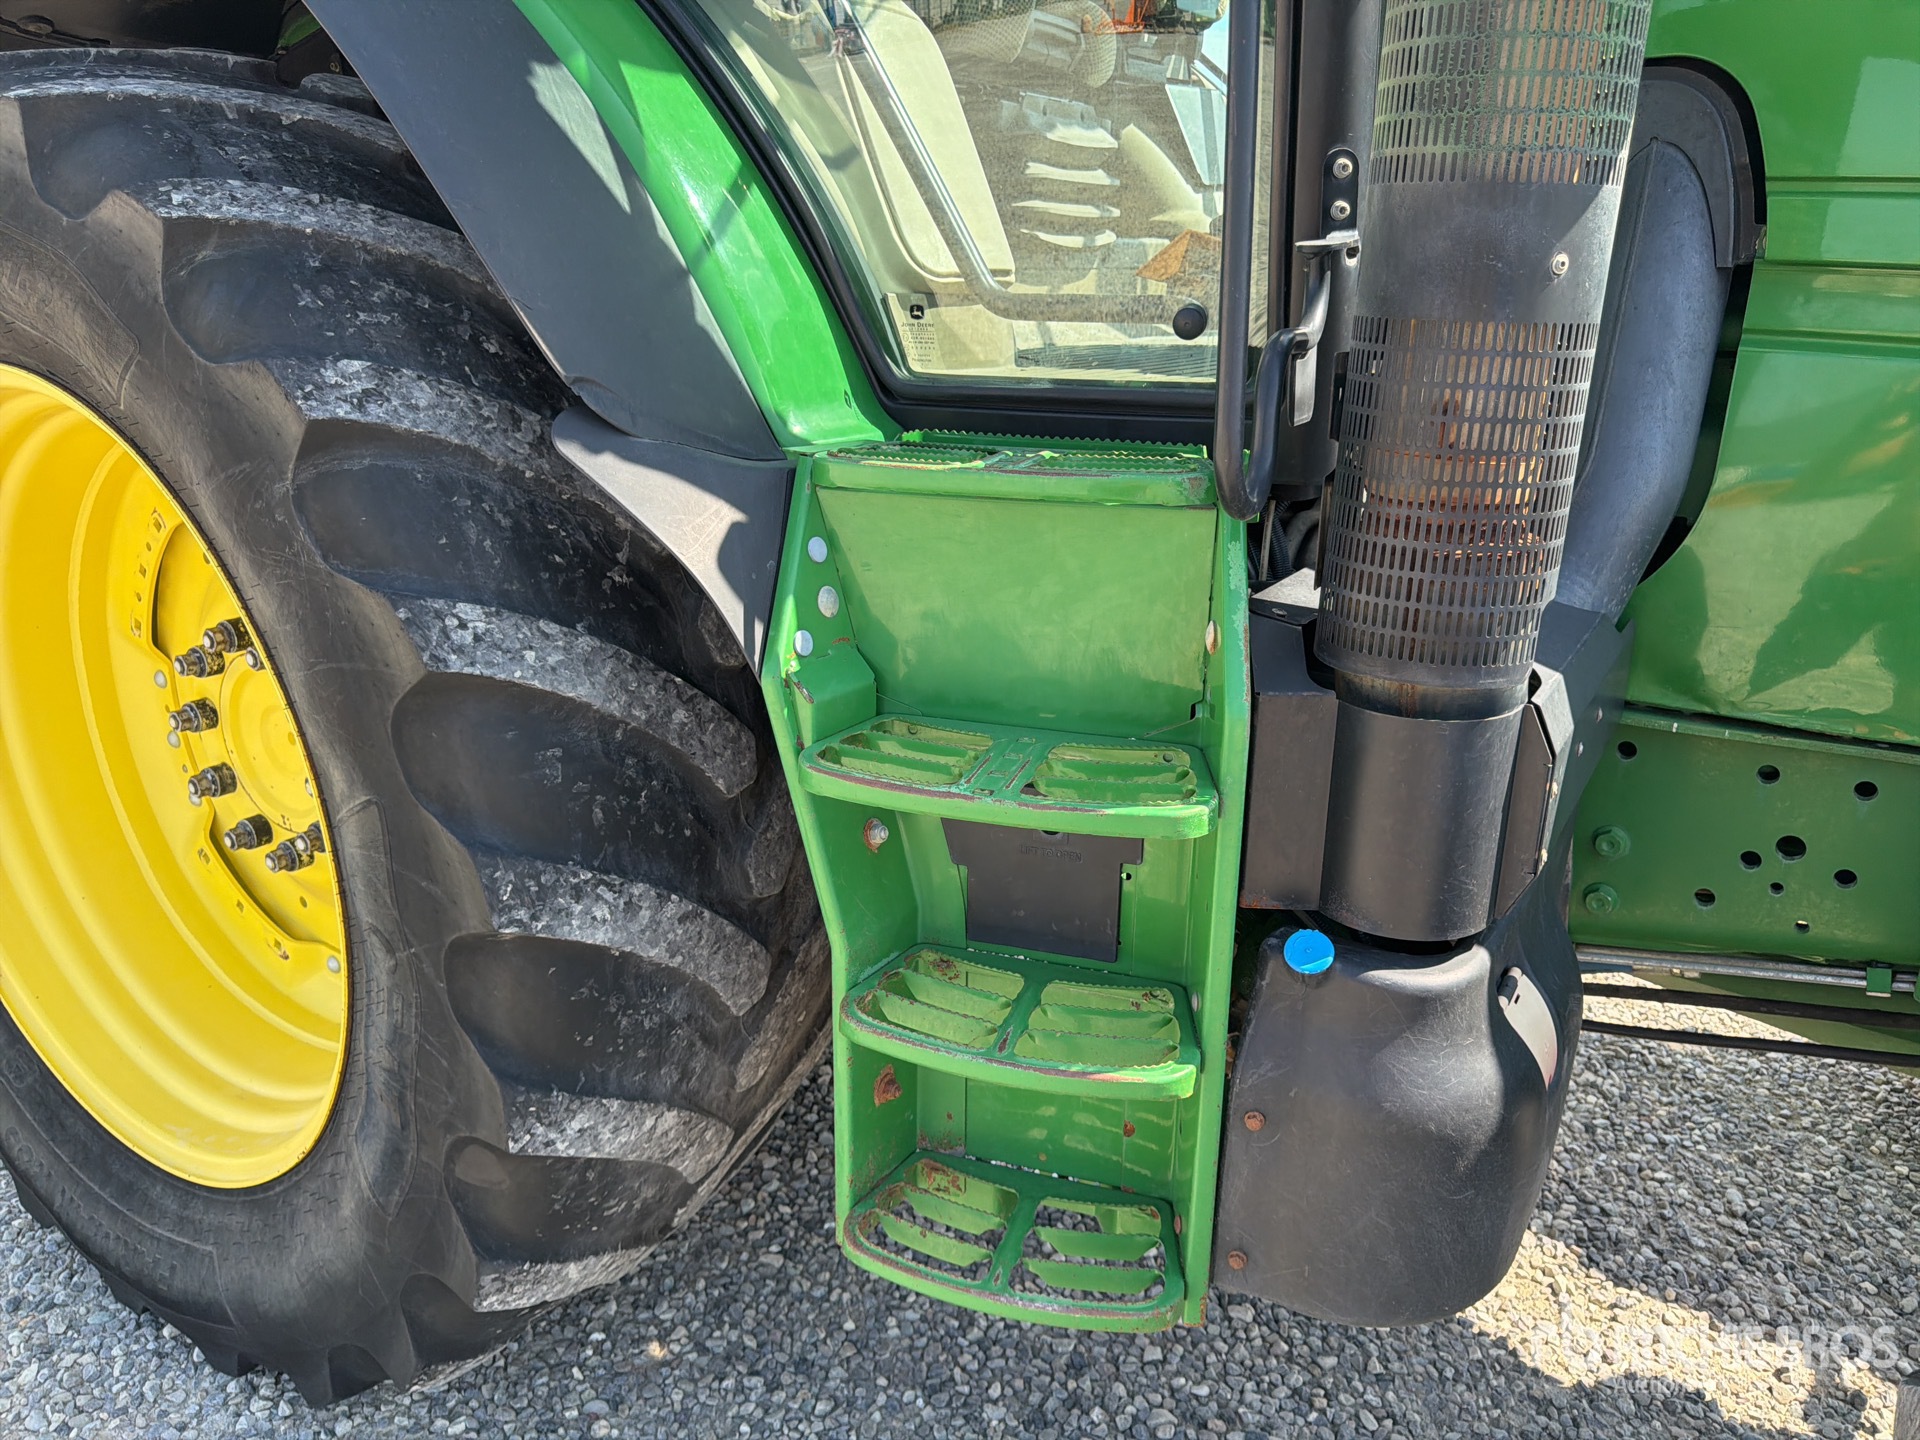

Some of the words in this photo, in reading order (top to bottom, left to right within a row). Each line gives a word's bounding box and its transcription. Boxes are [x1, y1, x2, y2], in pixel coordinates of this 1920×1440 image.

[1020, 845, 1039, 856] LIFT
[1040, 847, 1054, 858] TO
[1055, 849, 1082, 863] OPEN
